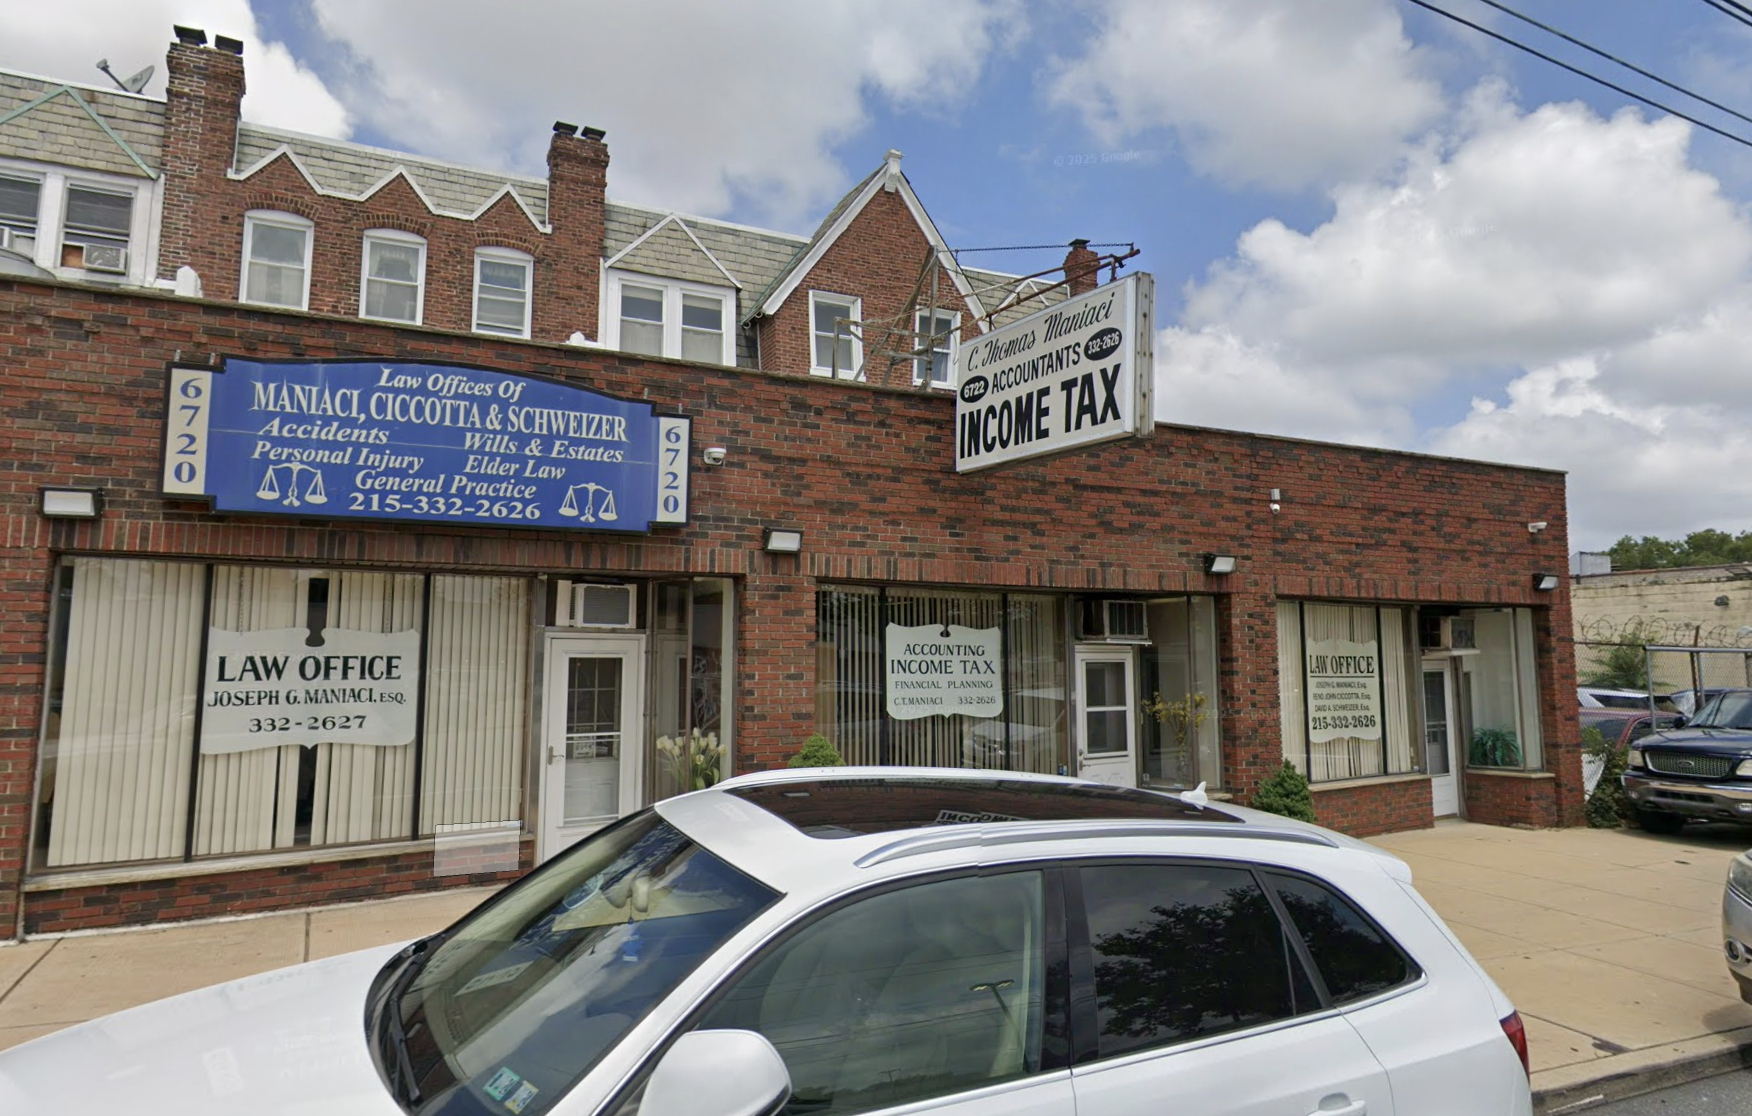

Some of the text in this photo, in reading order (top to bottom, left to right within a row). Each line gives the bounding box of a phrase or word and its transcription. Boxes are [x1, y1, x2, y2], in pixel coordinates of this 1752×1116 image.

[967, 291, 1115, 372] C. Thomas Maniaci
[1086, 328, 1120, 355] 332-2626
[991, 341, 1081, 395] ACCOUNTANTS
[378, 366, 526, 402] Law Offices Of
[963, 379, 986, 398] 6722
[250, 378, 630, 443] MANIACI, CICCOTTA & SCHWEIZER
[959, 362, 1122, 459] INCOME TAX
[174, 377, 203, 483] 6720
[257, 417, 389, 445] Accidents
[251, 440, 425, 475] Personal Injury
[464, 432, 624, 463] Wills & Estates
[463, 454, 567, 480] Elder Law
[663, 425, 682, 514] 6720
[355, 469, 538, 499] General Practice
[348, 492, 541, 520] 215-332-2626
[903, 643, 986, 657] ACCOUNTING
[216, 655, 402, 682] LAW OFFICE
[890, 659, 996, 675] INCOME TAX
[1308, 654, 1375, 675] LAW OFFICE
[207, 689, 280, 707] JOSEPH
[285, 688, 301, 706] G.
[379, 691, 407, 705] ESQ.
[895, 680, 993, 690] FINANCIAL PLANNING
[957, 696, 996, 705] 332-2626
[1312, 714, 1376, 730] 215-332-2626
